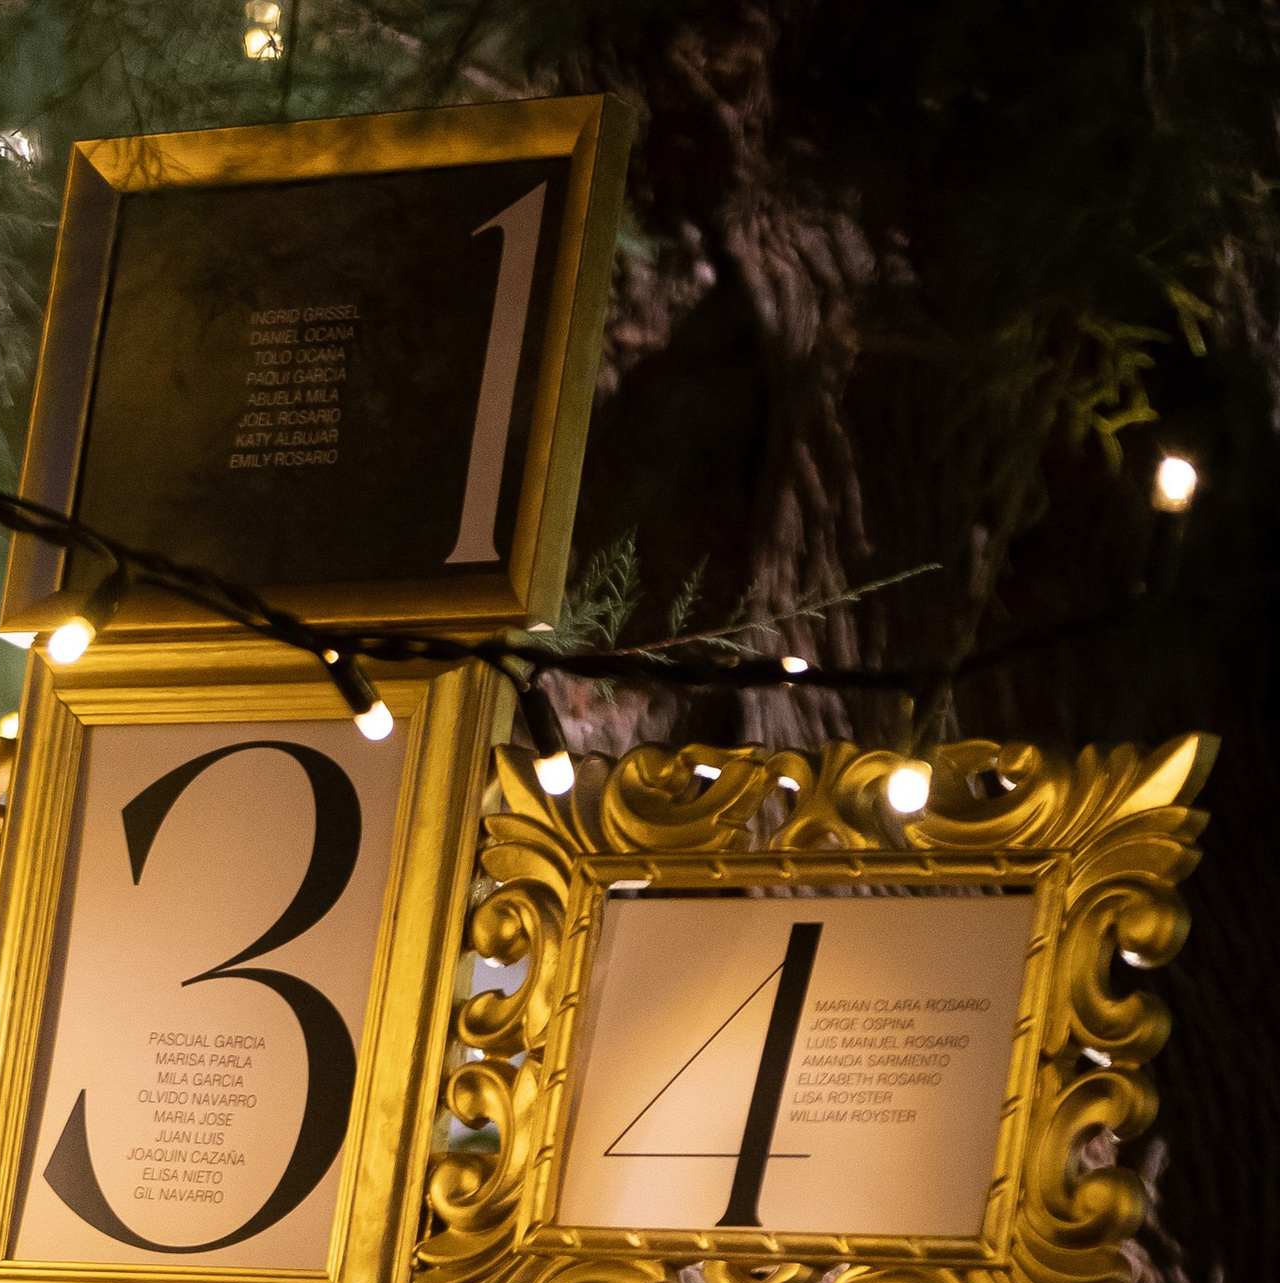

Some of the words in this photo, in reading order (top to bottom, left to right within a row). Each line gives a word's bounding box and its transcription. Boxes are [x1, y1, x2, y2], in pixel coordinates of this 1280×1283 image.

[250, 309, 300, 324] INGRID
[250, 329, 300, 345] DANIEL
[255, 350, 292, 365] TOLO
[246, 370, 290, 385] PAQUI
[445, 180, 547, 564] 1
[305, 389, 339, 403] MILA
[239, 412, 273, 428] JOEL
[278, 408, 341, 425] ROSARIO
[235, 432, 272, 447] KATY
[229, 452, 272, 468] EMILY
[274, 449, 338, 466] ROSARIO
[43, 740, 362, 1254] 3
[874, 999, 921, 1012] CLARA
[925, 998, 990, 1012] ROSARIO
[810, 1018, 860, 1030] JORGE
[862, 1018, 915, 1030] OSPINA
[149, 1032, 210, 1047] PASCUAL
[807, 1036, 838, 1049] LUIS
[841, 1036, 899, 1049] MANUEL
[904, 1035, 969, 1049] ROSARIO
[156, 1053, 205, 1067] MARISA
[210, 1055, 252, 1068] PARLA
[802, 1054, 863, 1067] AMANDA
[868, 1054, 950, 1067] SARMIENTO
[157, 1072, 188, 1085] MILA
[604, 922, 824, 1227] 4
[798, 1073, 873, 1086] ELIZABETH
[877, 1072, 942, 1086] ROSARIO
[138, 1089, 188, 1105] OLVIDO
[192, 1092, 257, 1108] NAVARRO
[793, 1091, 823, 1104] LISA
[828, 1091, 893, 1104] ROYSTER
[790, 1110, 848, 1123] WILLIAM
[851, 1110, 916, 1123] ROYSTER
[155, 1130, 191, 1144] JUAN
[194, 1131, 224, 1145] LUIS
[127, 1148, 186, 1163] JOAQUIN
[190, 1150, 245, 1165] CAZAÑA
[142, 1167, 179, 1182] ELISA
[182, 1169, 222, 1184] NIETO
[134, 1186, 155, 1200] GIL
[159, 1188, 224, 1204] NAVARRO
